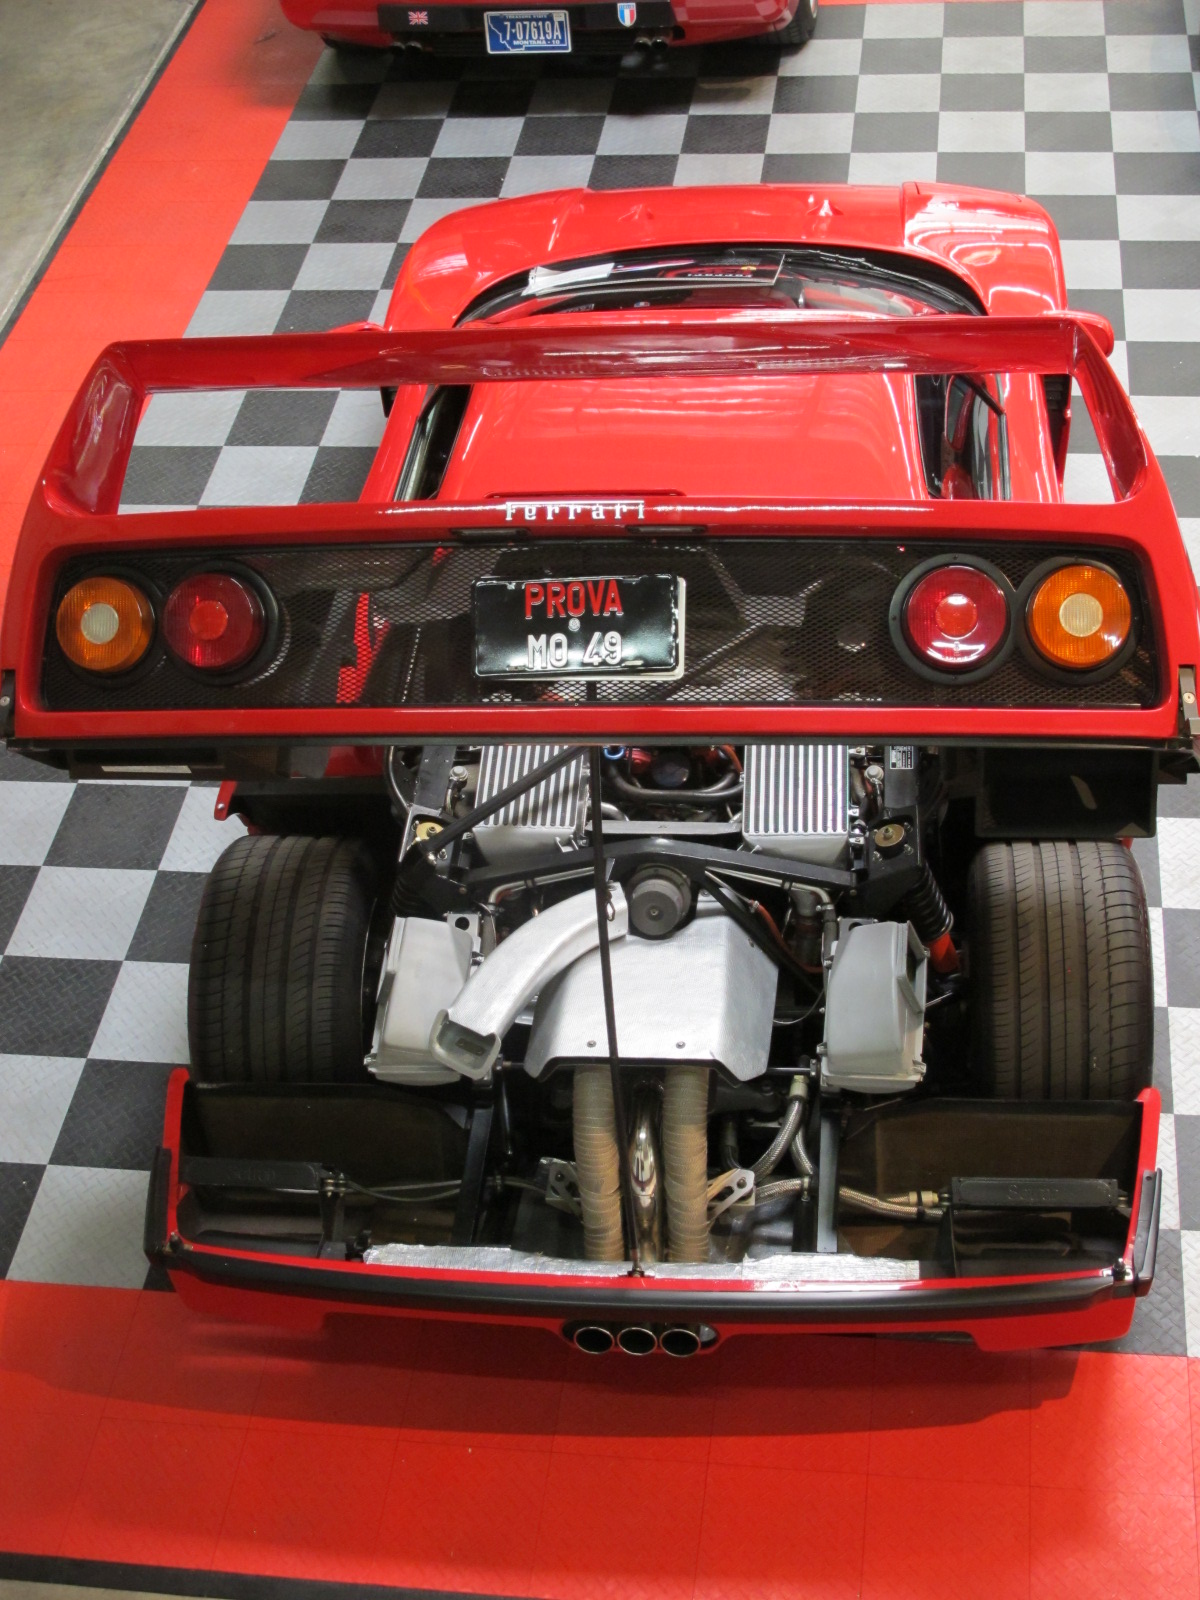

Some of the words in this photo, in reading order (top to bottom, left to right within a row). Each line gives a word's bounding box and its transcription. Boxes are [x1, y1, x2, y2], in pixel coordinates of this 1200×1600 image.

[505, 500, 645, 521] Ferrari
[525, 578, 623, 619] PROVA
[527, 633, 568, 669] MO
[582, 630, 622, 666] 49
